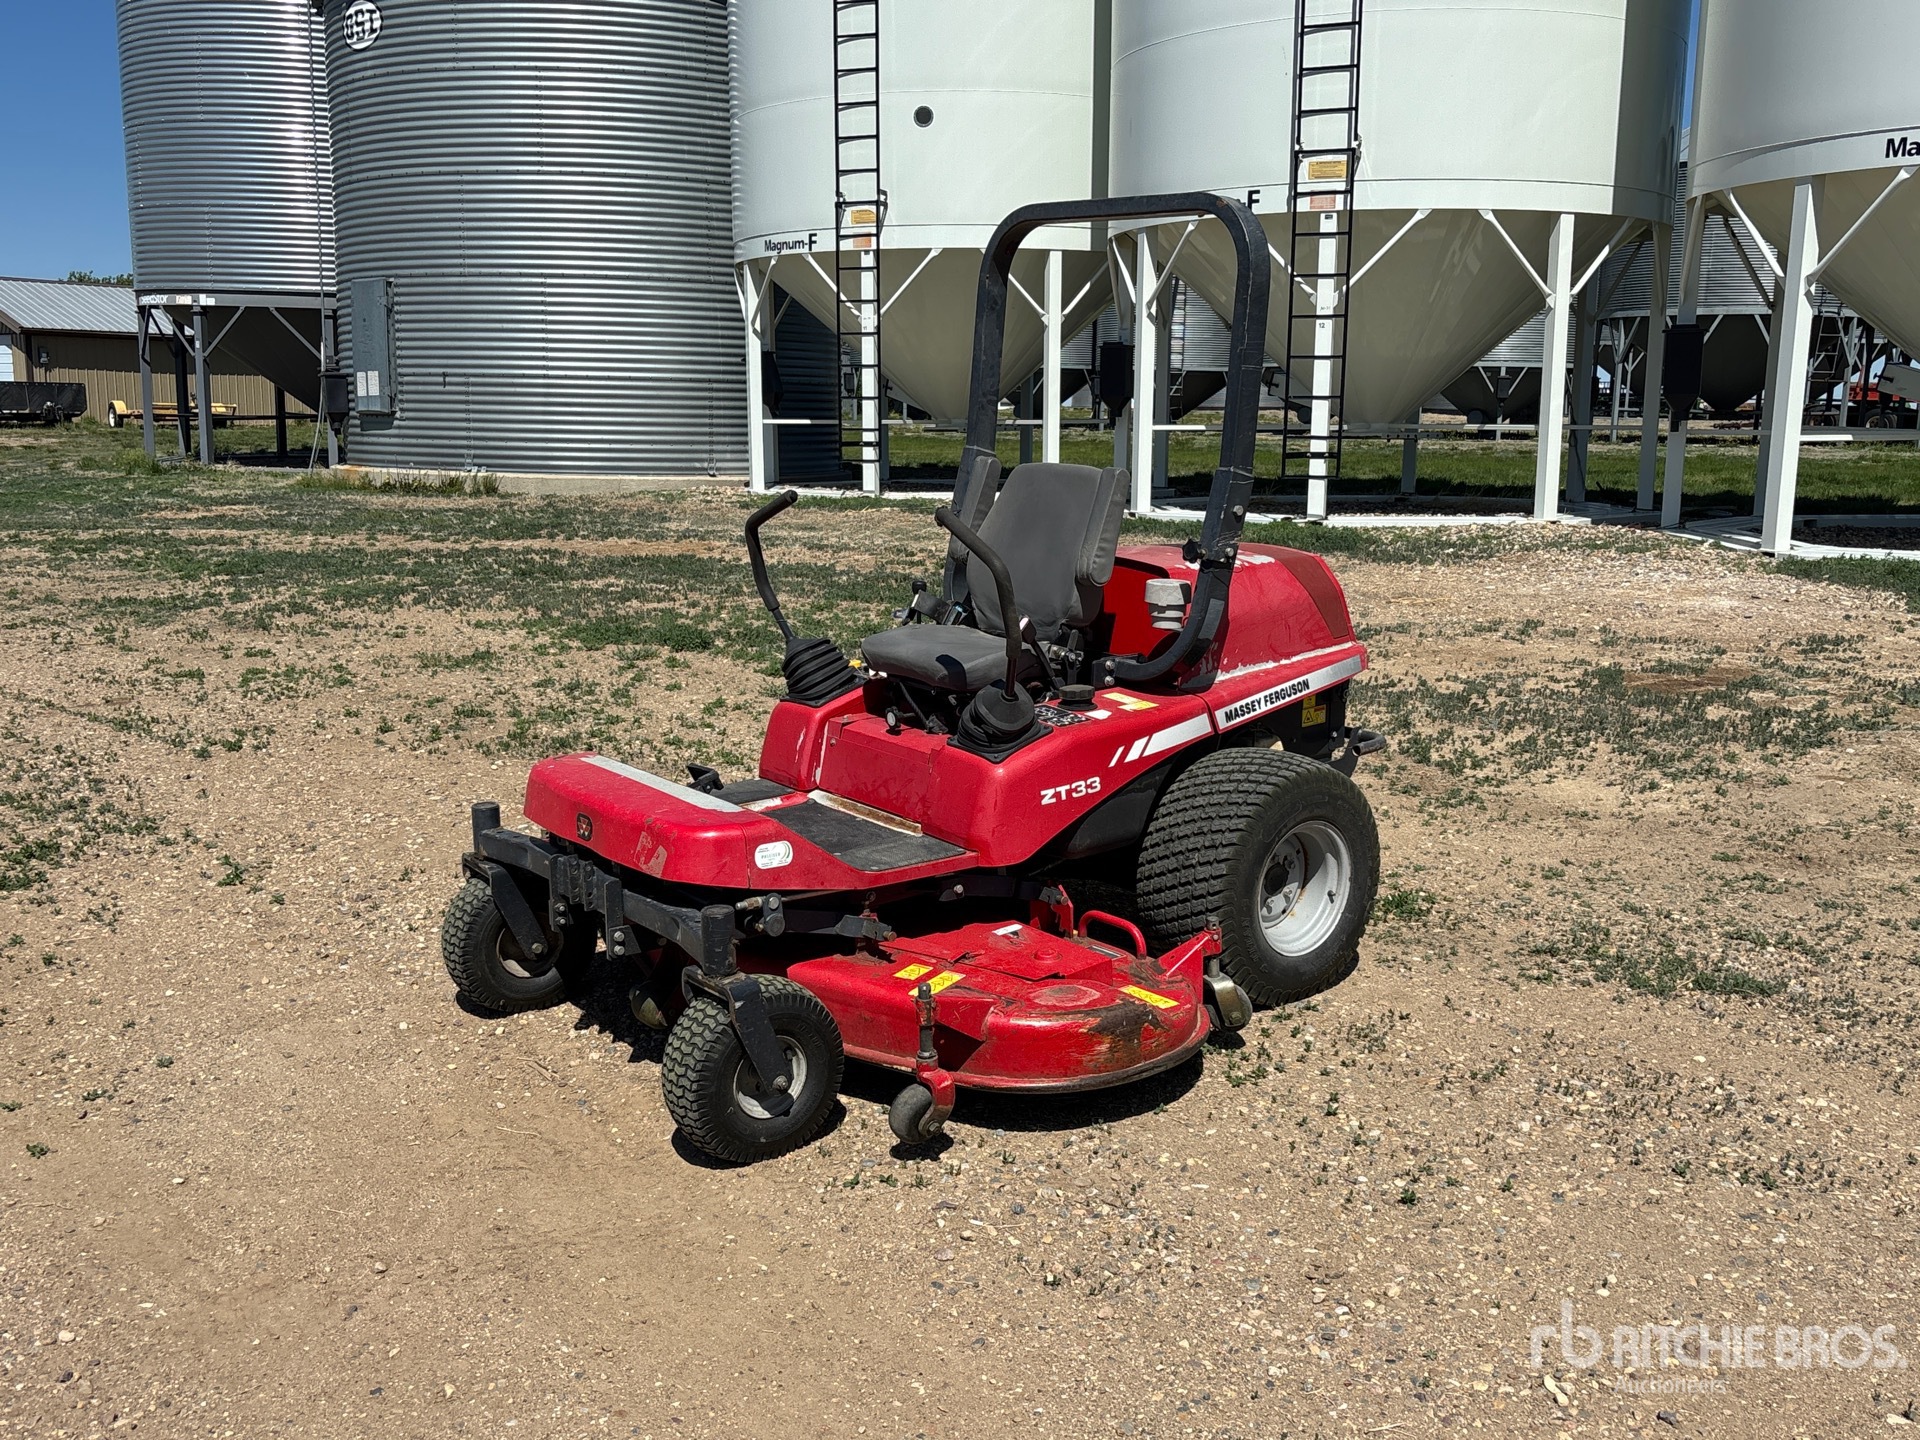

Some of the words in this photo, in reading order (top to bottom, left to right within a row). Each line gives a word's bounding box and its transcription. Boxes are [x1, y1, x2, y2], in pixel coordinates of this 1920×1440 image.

[345, 8, 377, 41] GSI
[764, 232, 818, 254] Magnum-F
[1224, 697, 1262, 724] MASSEY
[1263, 678, 1310, 708] FERGUSON
[1040, 776, 1102, 806] ZT33
